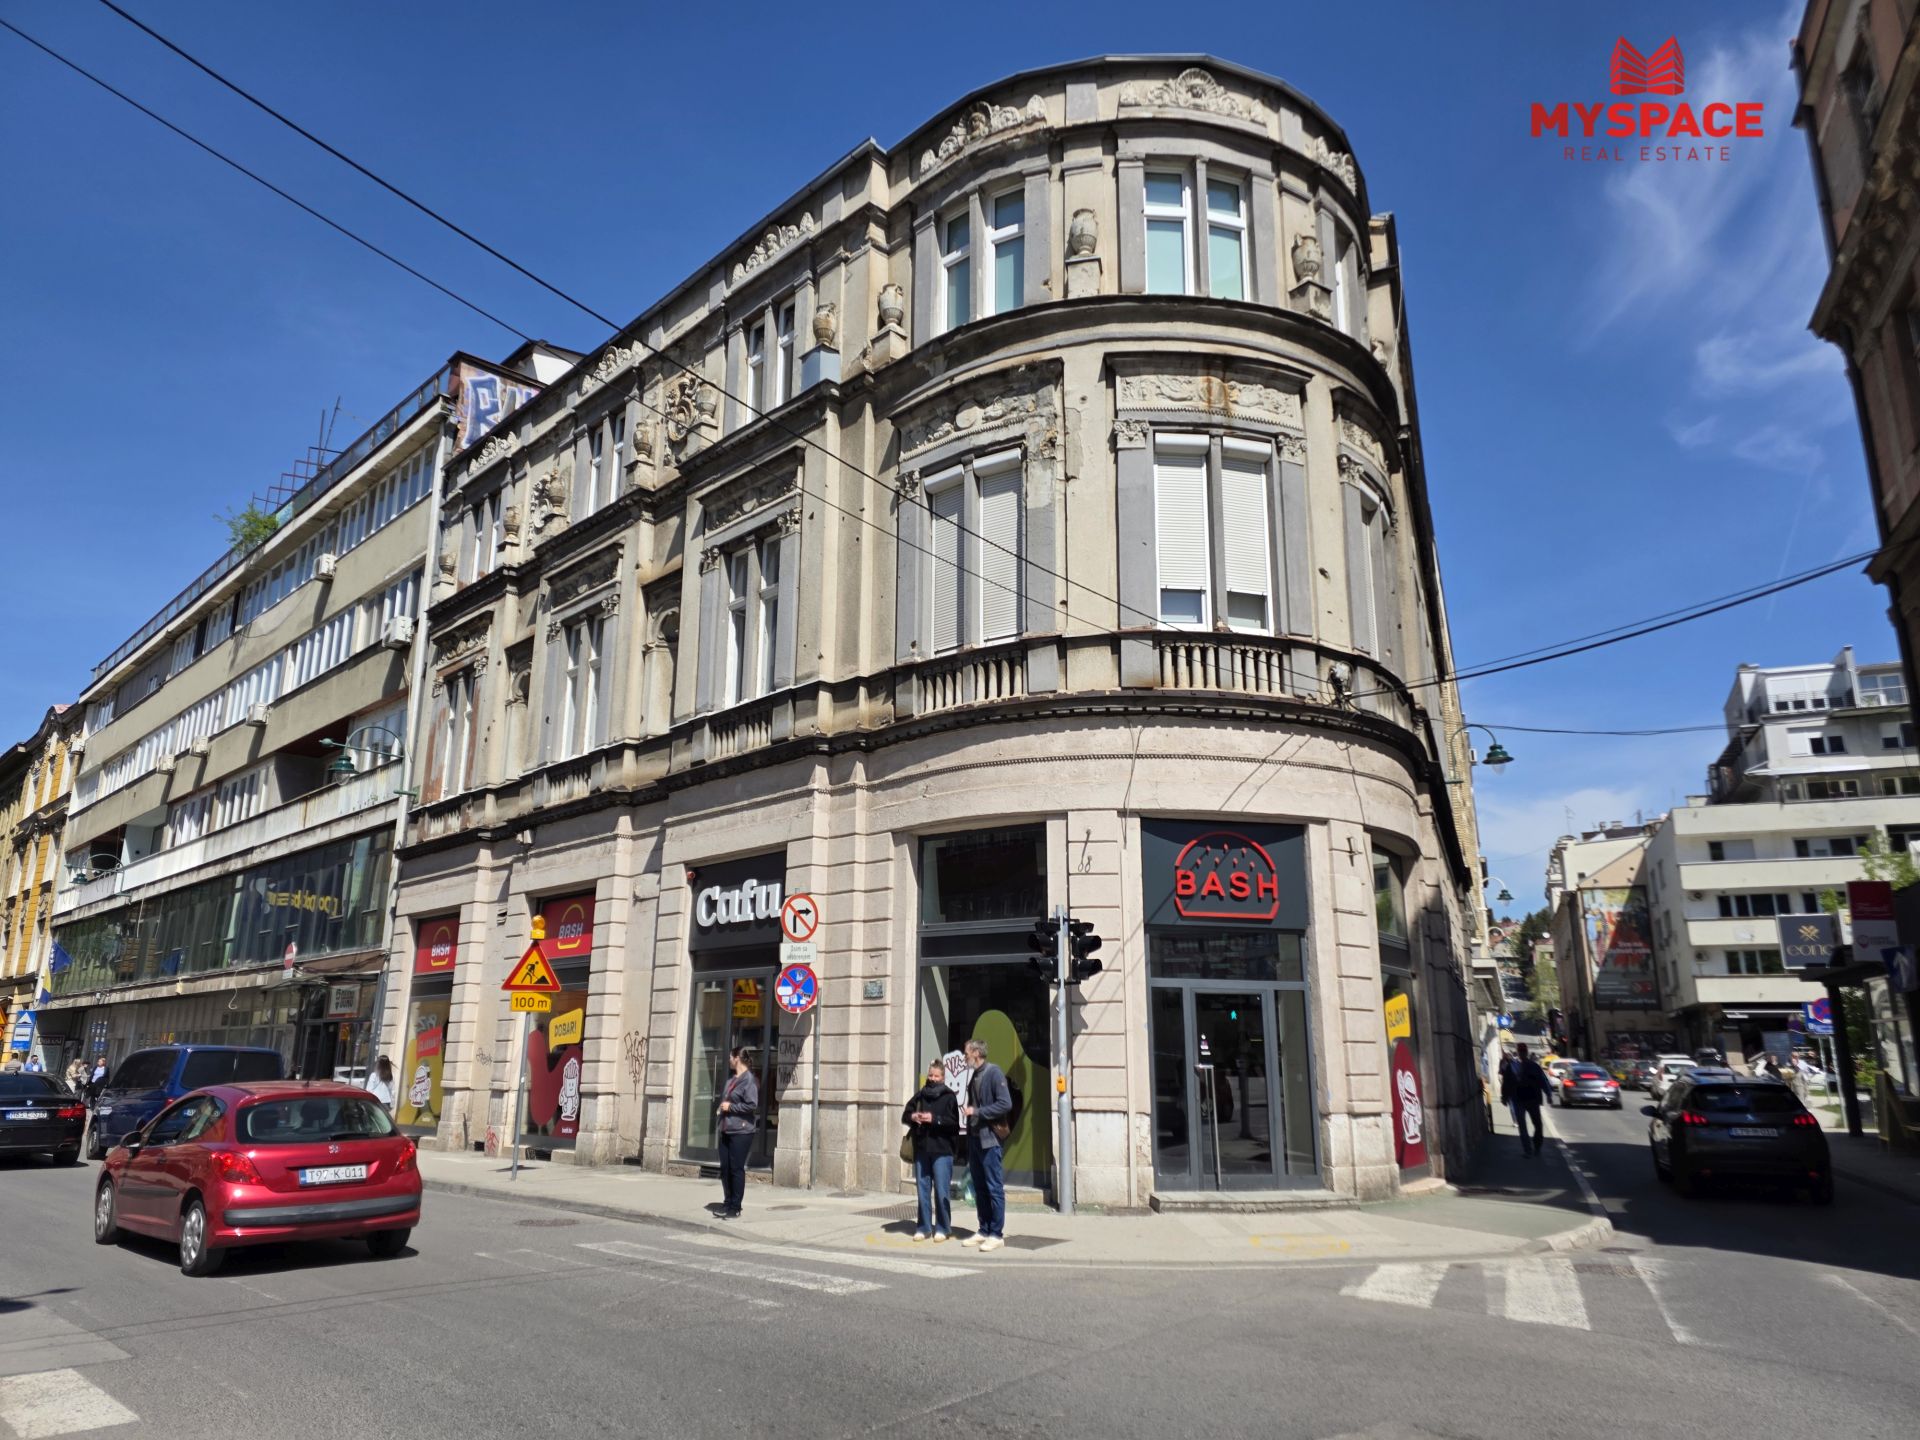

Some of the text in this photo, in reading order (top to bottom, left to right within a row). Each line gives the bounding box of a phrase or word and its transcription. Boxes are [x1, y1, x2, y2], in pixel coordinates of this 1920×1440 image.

[1176, 869, 1279, 900] BASH
[696, 879, 782, 927] Cafu
[558, 922, 583, 940] BASH
[431, 943, 450, 958] BASH
[514, 997, 548, 1009] 100 m
